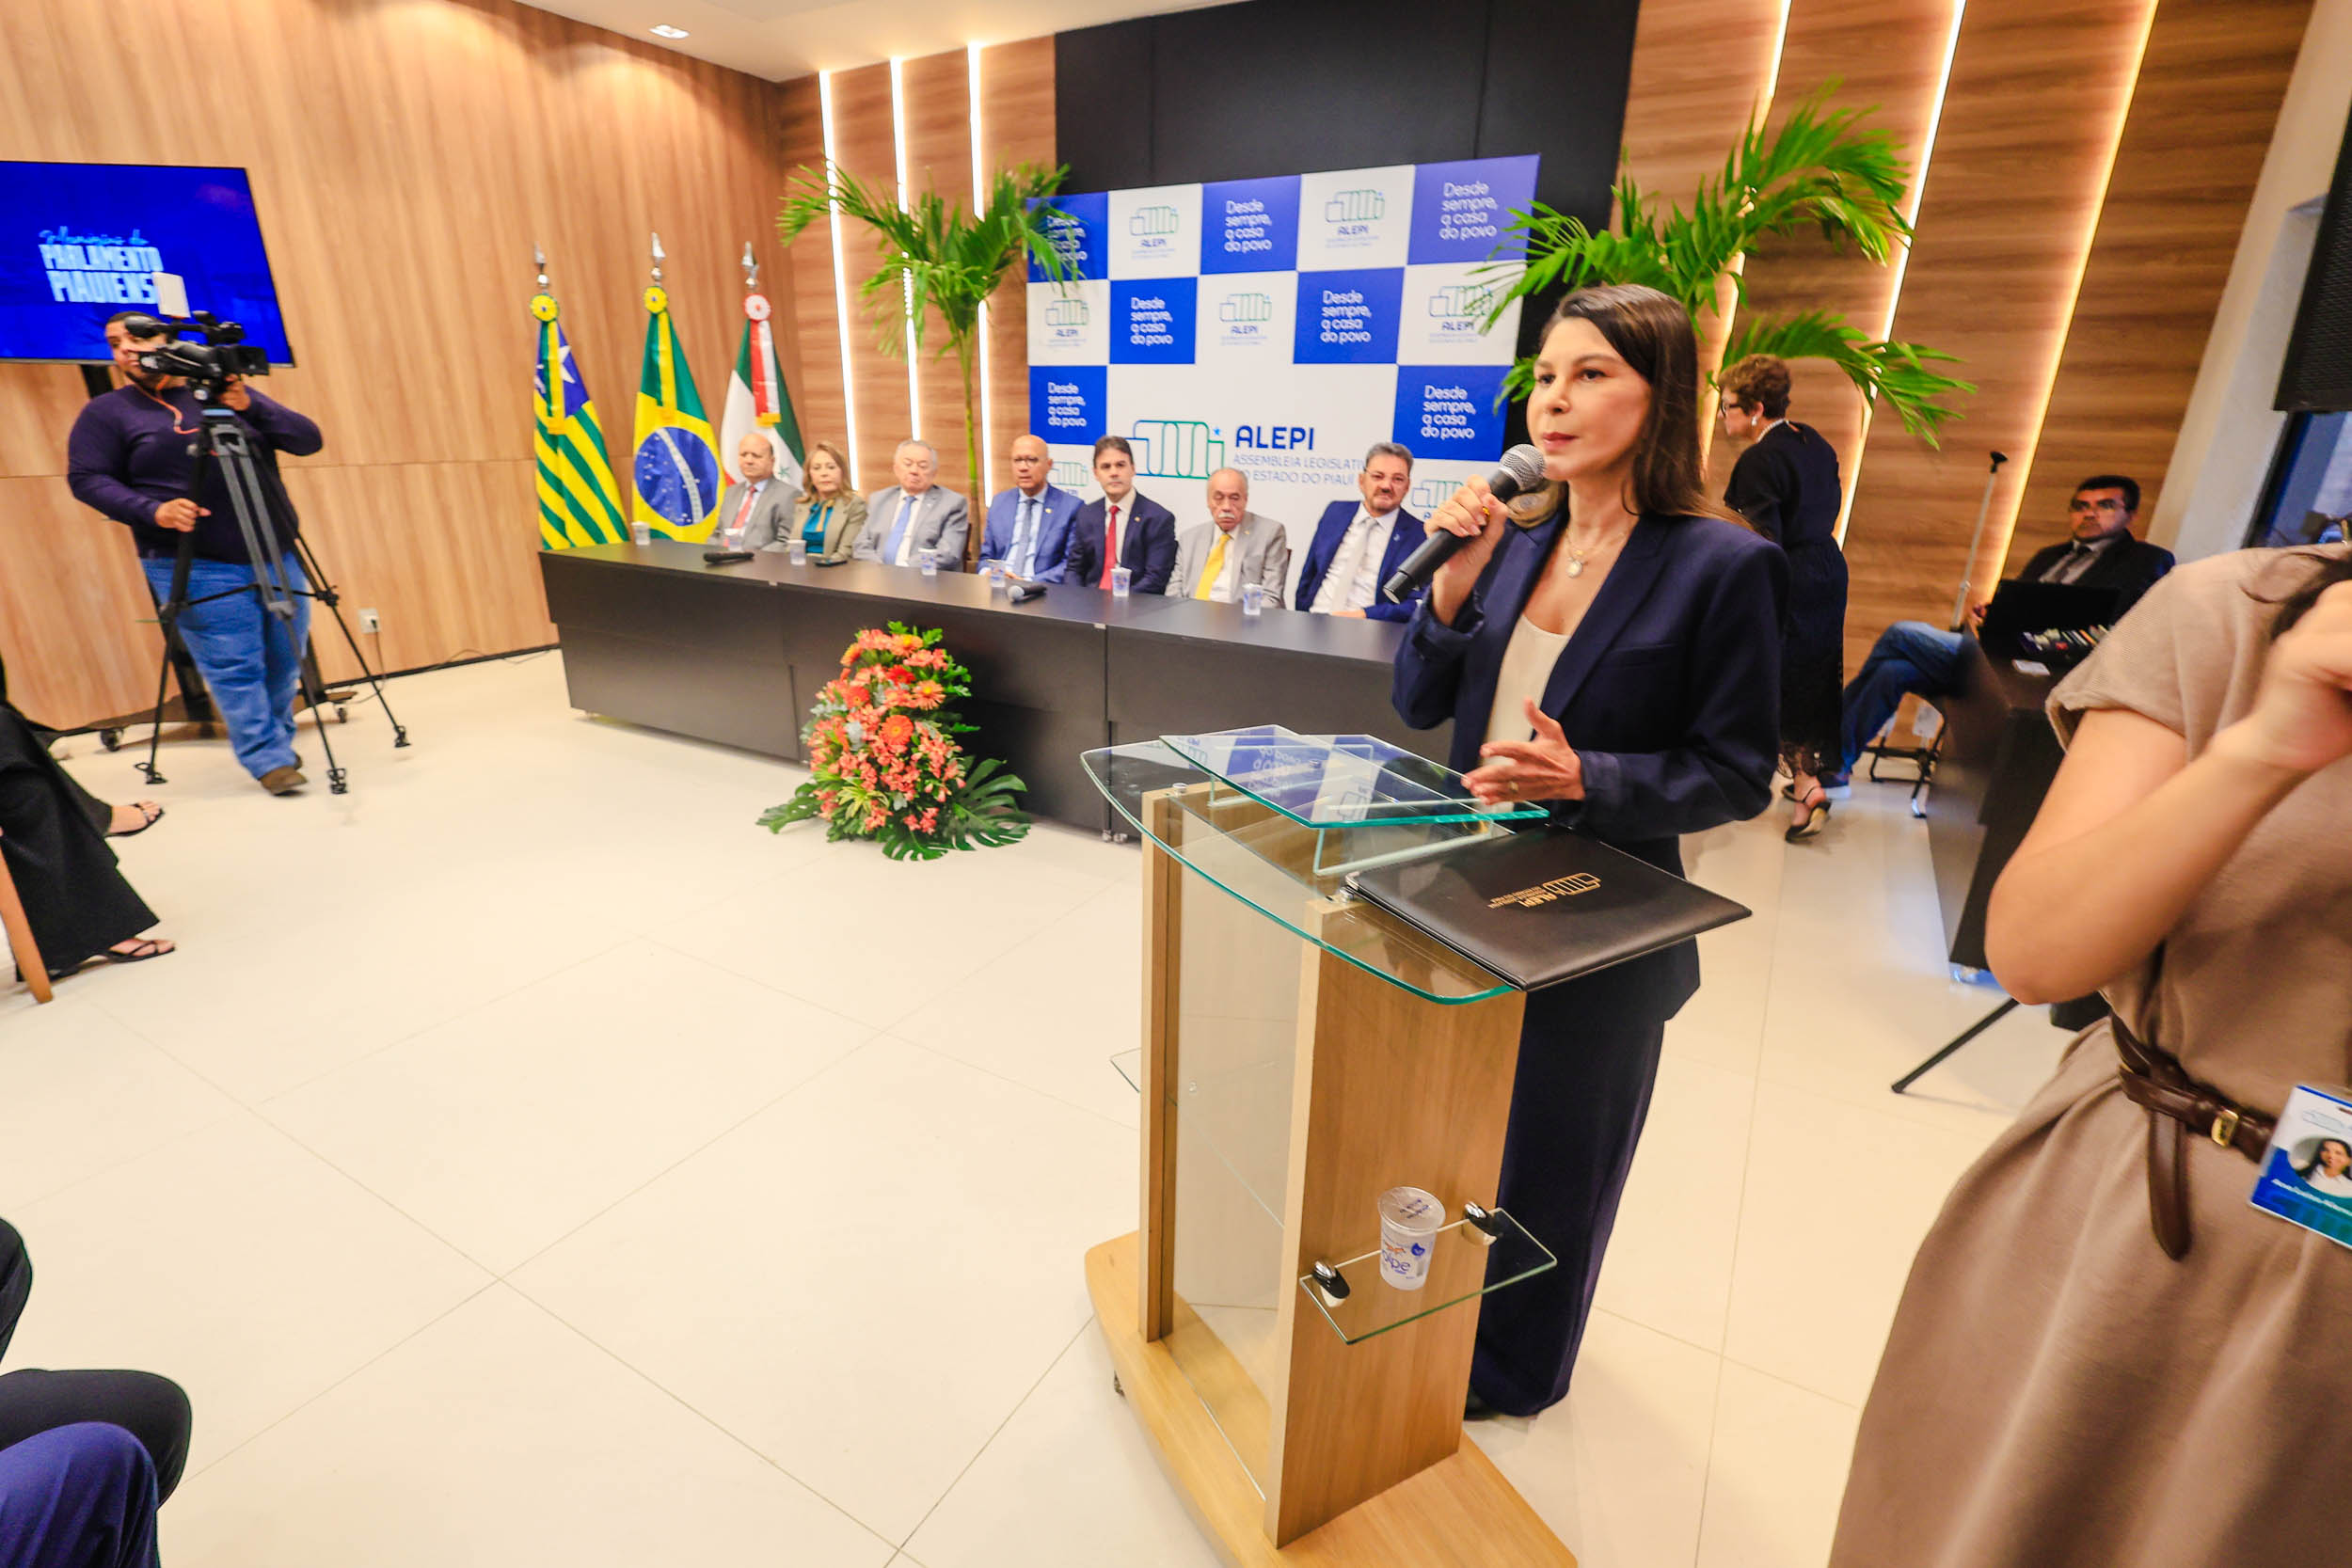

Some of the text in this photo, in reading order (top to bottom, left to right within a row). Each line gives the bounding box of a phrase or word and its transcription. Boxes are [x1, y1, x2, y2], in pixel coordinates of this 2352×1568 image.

[1443, 181, 1489, 198] Desde
[1226, 198, 1264, 214] Desde
[1441, 196, 1498, 212] sempre,
[1225, 214, 1272, 227] sempre,
[1440, 212, 1488, 226] a casa
[1225, 227, 1264, 239] a casa
[1338, 225, 1368, 235] ALEPI
[1438, 225, 1498, 241] do povo
[1140, 238, 1167, 247] ALEPI
[1224, 239, 1272, 253] do povo
[38, 245, 164, 272] PARLAMENTO
[46, 271, 158, 304] PIAUIENS
[1131, 296, 1166, 310] Desde
[1322, 289, 1363, 305] Desde
[1130, 310, 1173, 323] sempre,
[1322, 305, 1372, 318] sempre,
[1130, 323, 1167, 333] a casa
[1231, 325, 1259, 334] ALEPI
[1321, 319, 1363, 330] a casa
[1441, 322, 1474, 331] ALEPI
[1130, 333, 1174, 346] do povo
[1320, 330, 1372, 344] do povo
[1047, 382, 1079, 394] Desde
[1424, 385, 1468, 400] Desde
[1047, 396, 1086, 406] sempre,
[1047, 406, 1080, 416] a casa
[1422, 401, 1476, 415] sempre,
[1047, 415, 1087, 428] do povo
[1422, 414, 1467, 425] a casa
[1235, 425, 1314, 450] ALEPI
[1421, 425, 1475, 440] do povo
[1233, 453, 1301, 467] ASSEMBLEIA
[1253, 471, 1298, 483] ESTADO
[1301, 473, 1321, 484] DO
